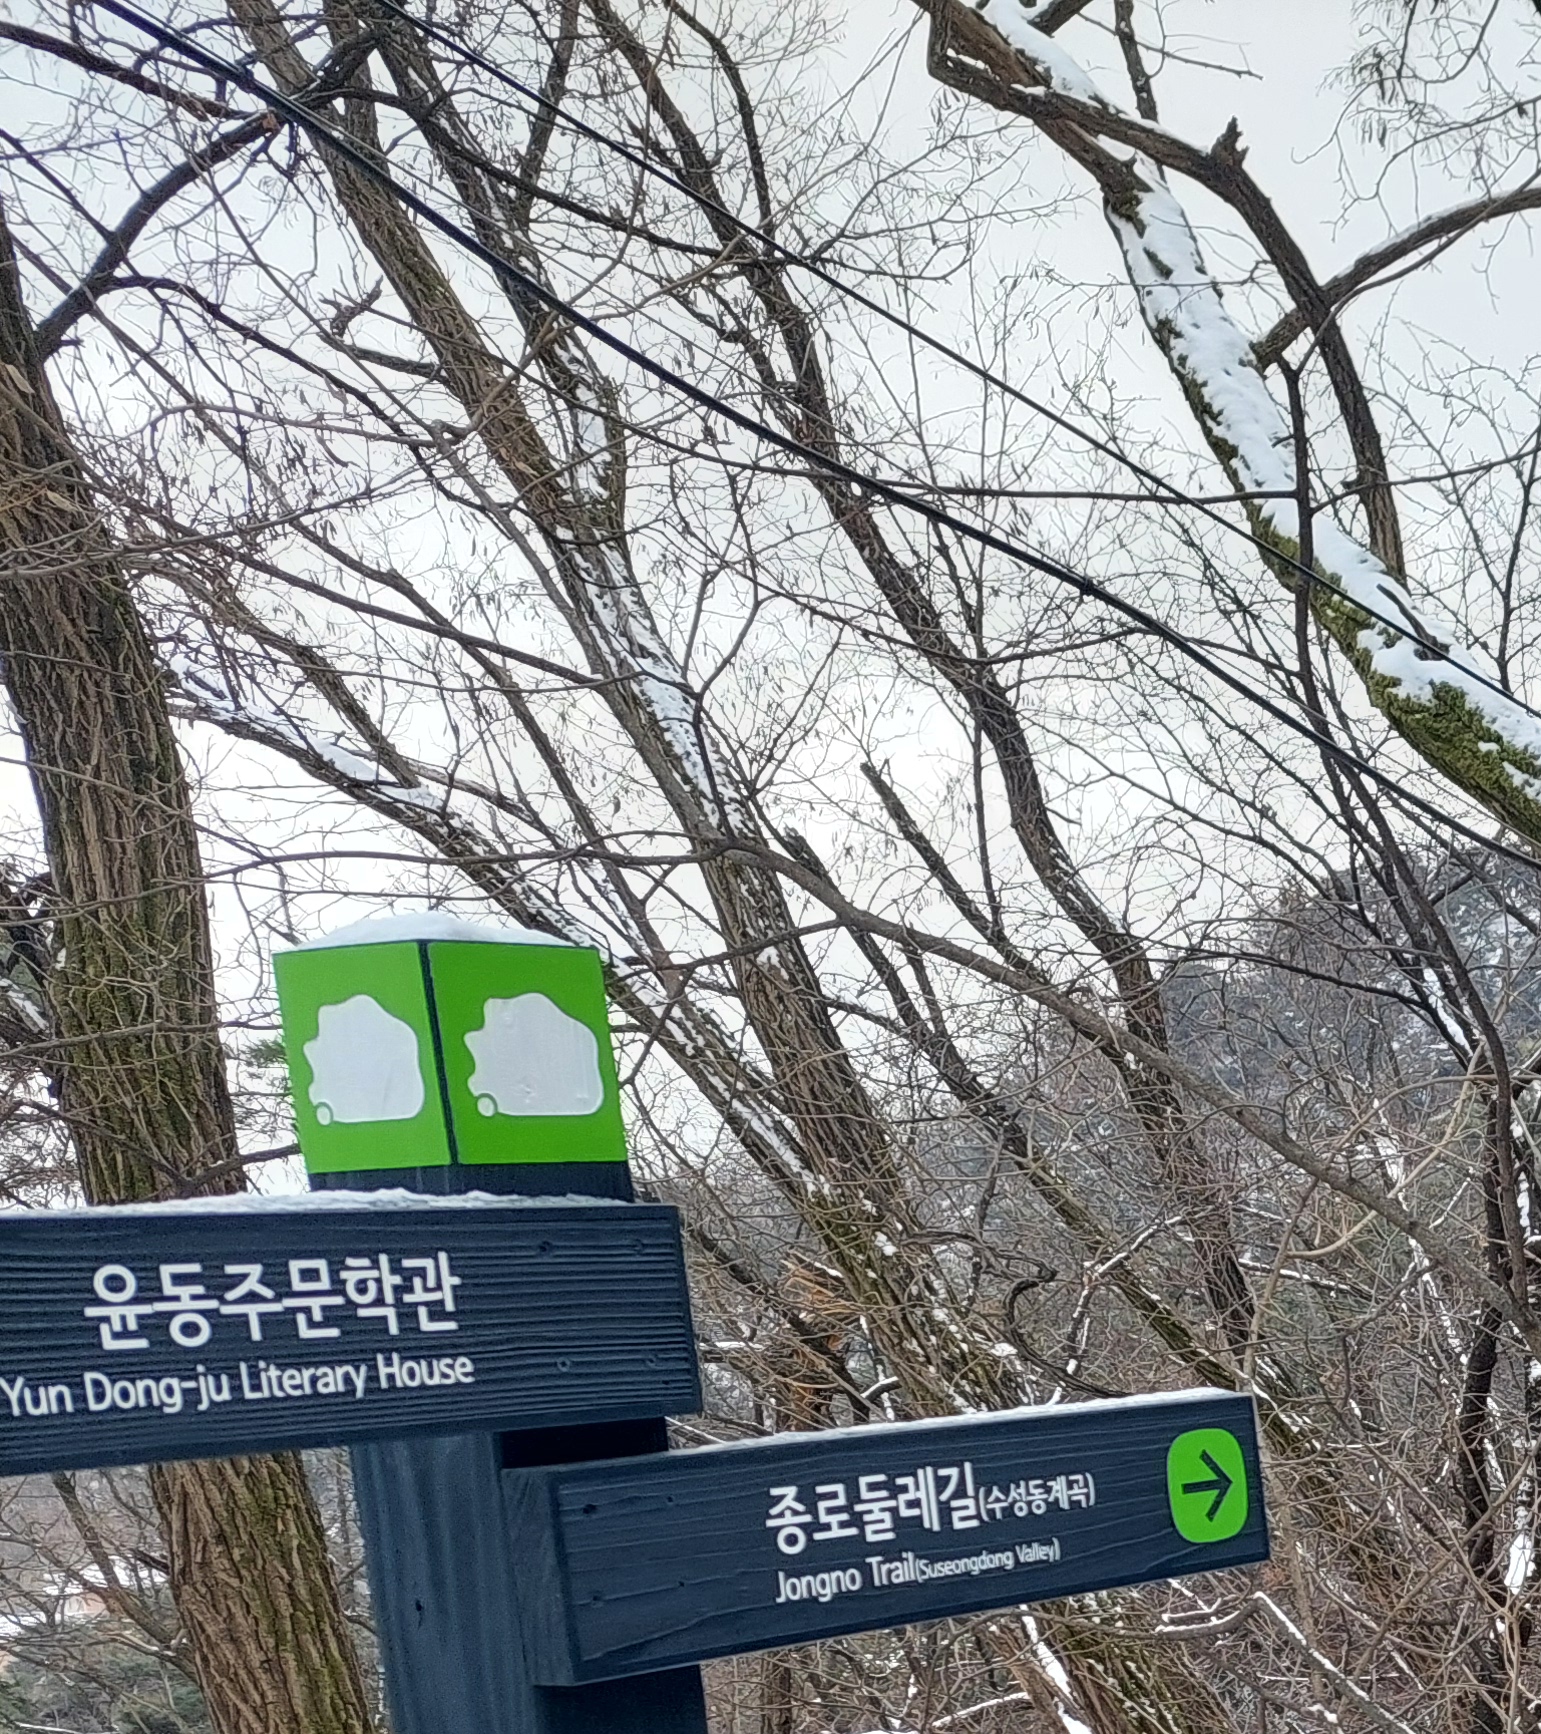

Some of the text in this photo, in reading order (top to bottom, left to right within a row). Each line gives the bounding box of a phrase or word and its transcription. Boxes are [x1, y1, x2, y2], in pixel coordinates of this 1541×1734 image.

[83, 1251, 462, 1351] 윤동주문학관
[0, 1351, 476, 1417] Yun Dong-ju Literary House
[775, 1568, 863, 1604] Jongno
[1015, 1537, 1062, 1564] Valley)
